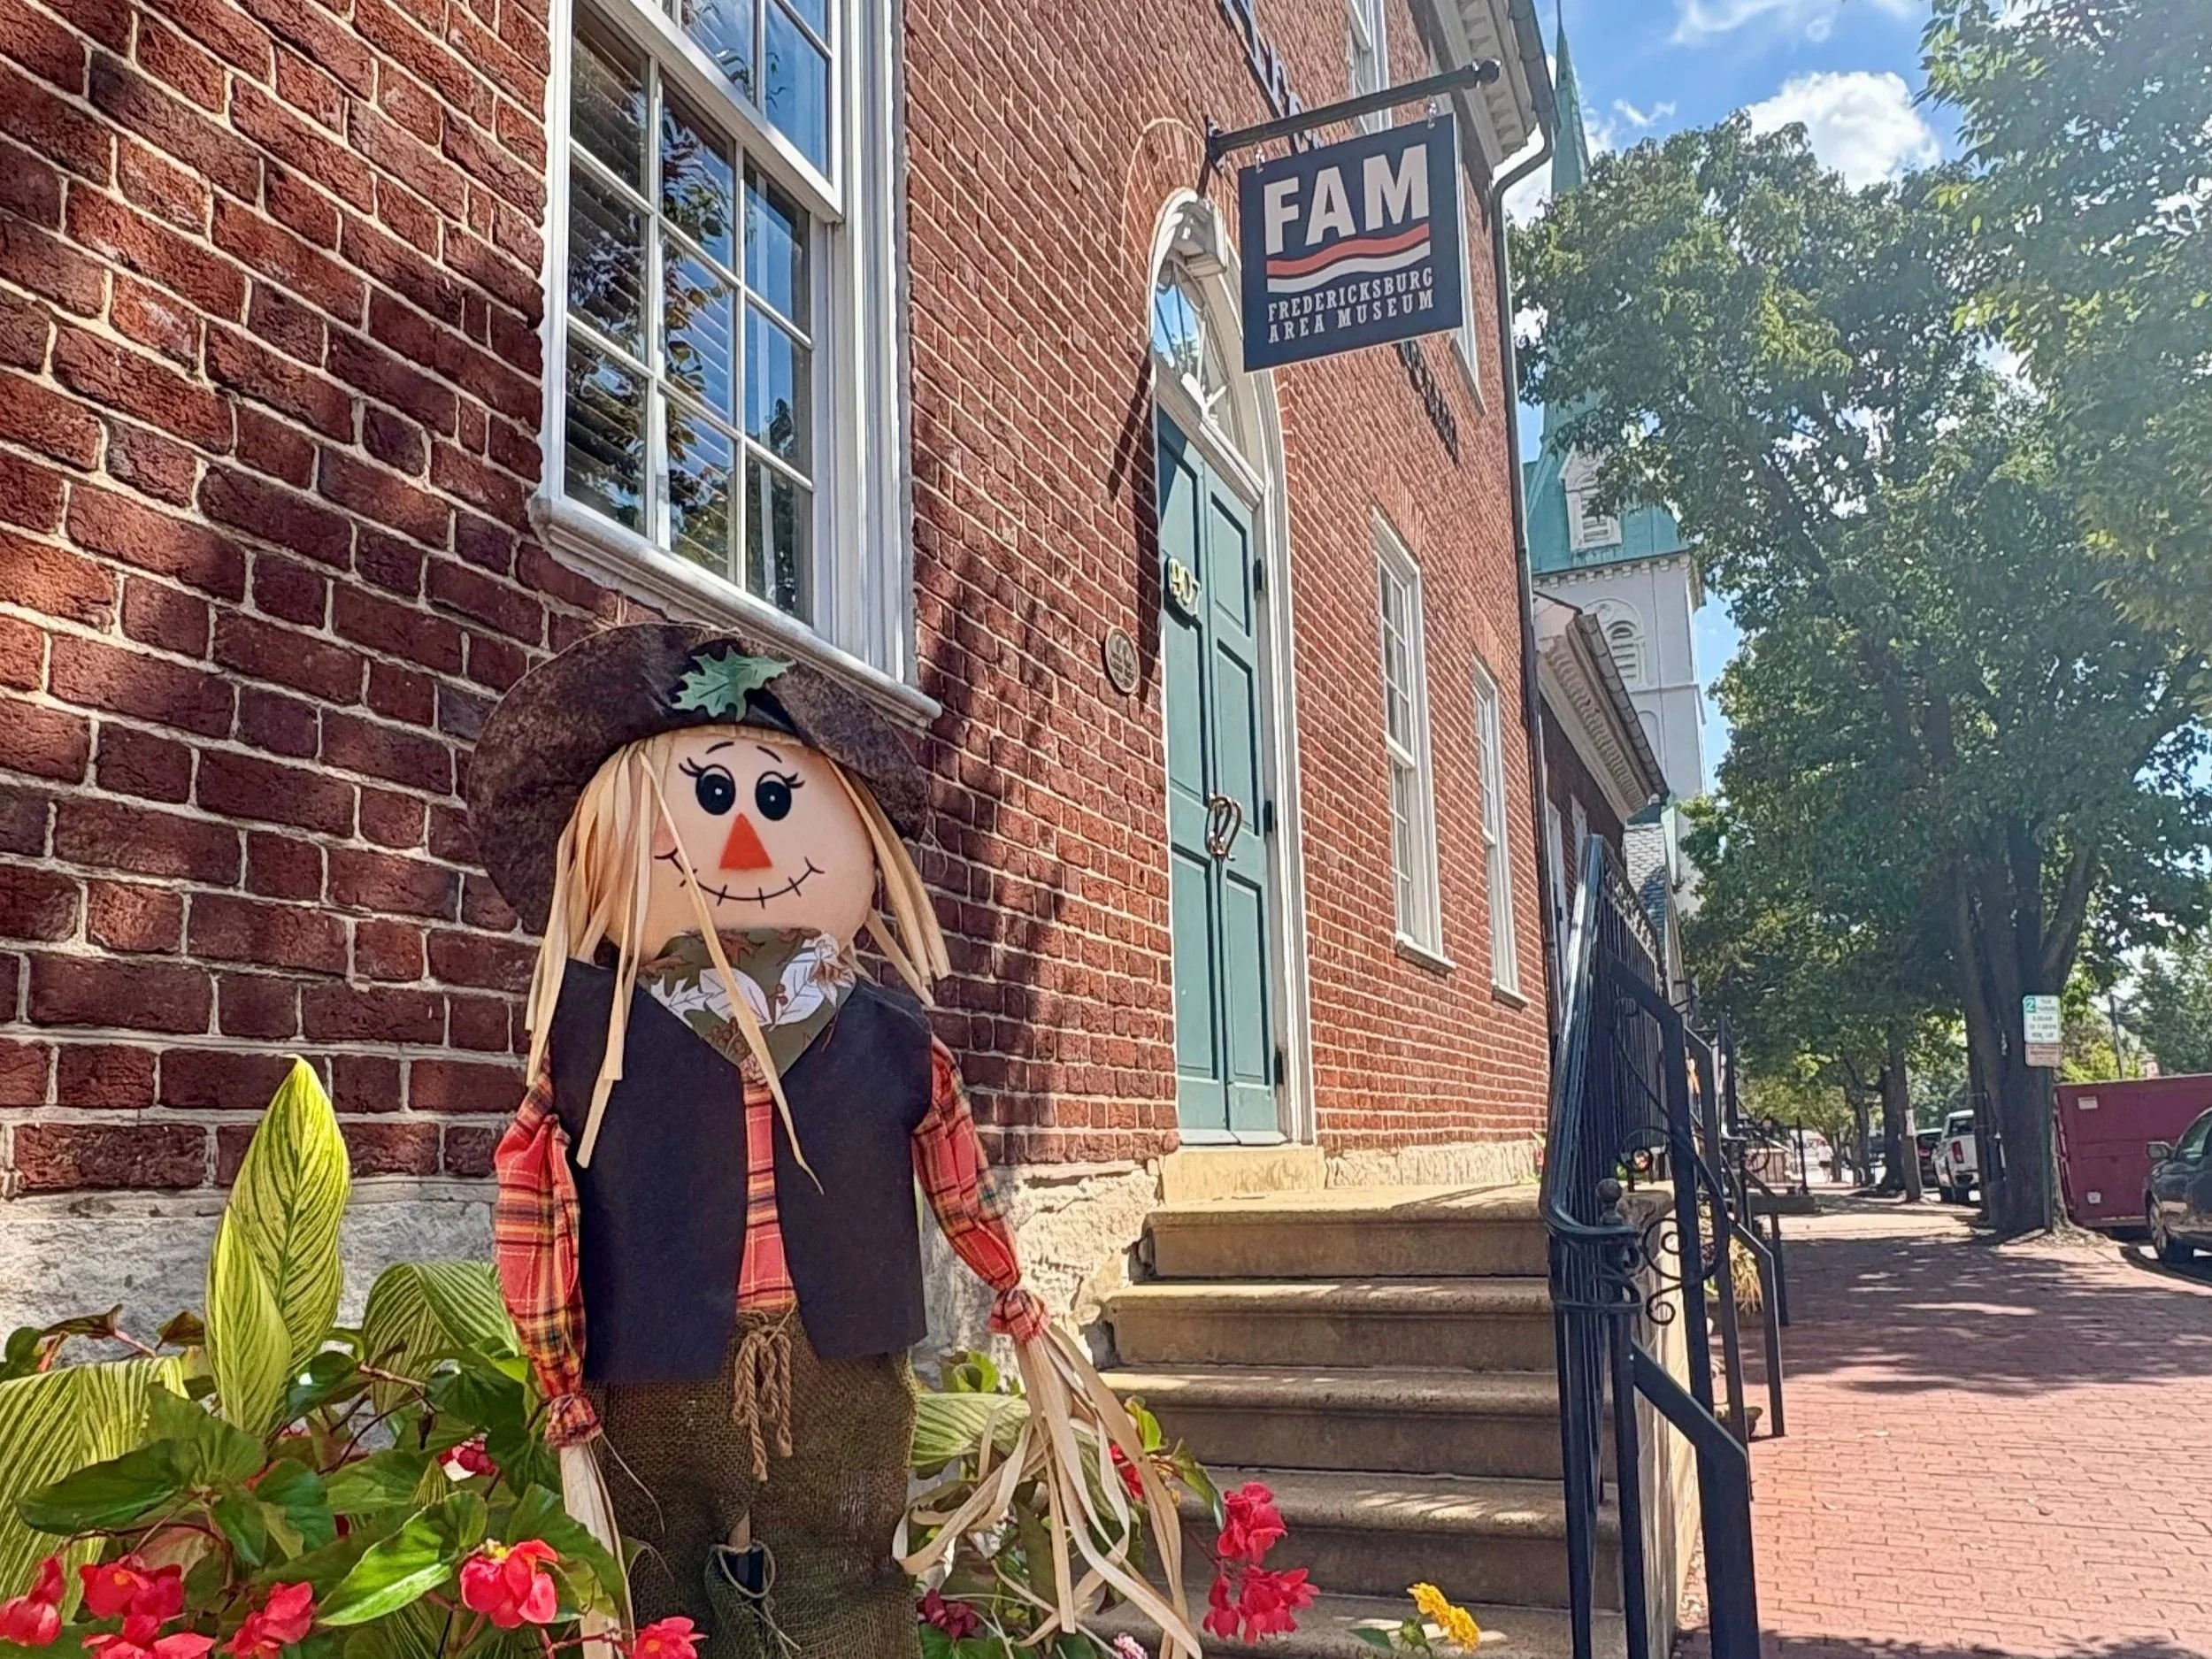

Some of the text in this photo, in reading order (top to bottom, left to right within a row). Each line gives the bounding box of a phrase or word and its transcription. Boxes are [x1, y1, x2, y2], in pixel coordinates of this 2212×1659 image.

[1263, 143, 1430, 256] FAM
[1267, 267, 1433, 323] FREDERICKSBURG
[1268, 289, 1433, 344] AREA MUSEUM
[1168, 558, 1201, 616] 907
[2025, 998, 2035, 1011] 2
